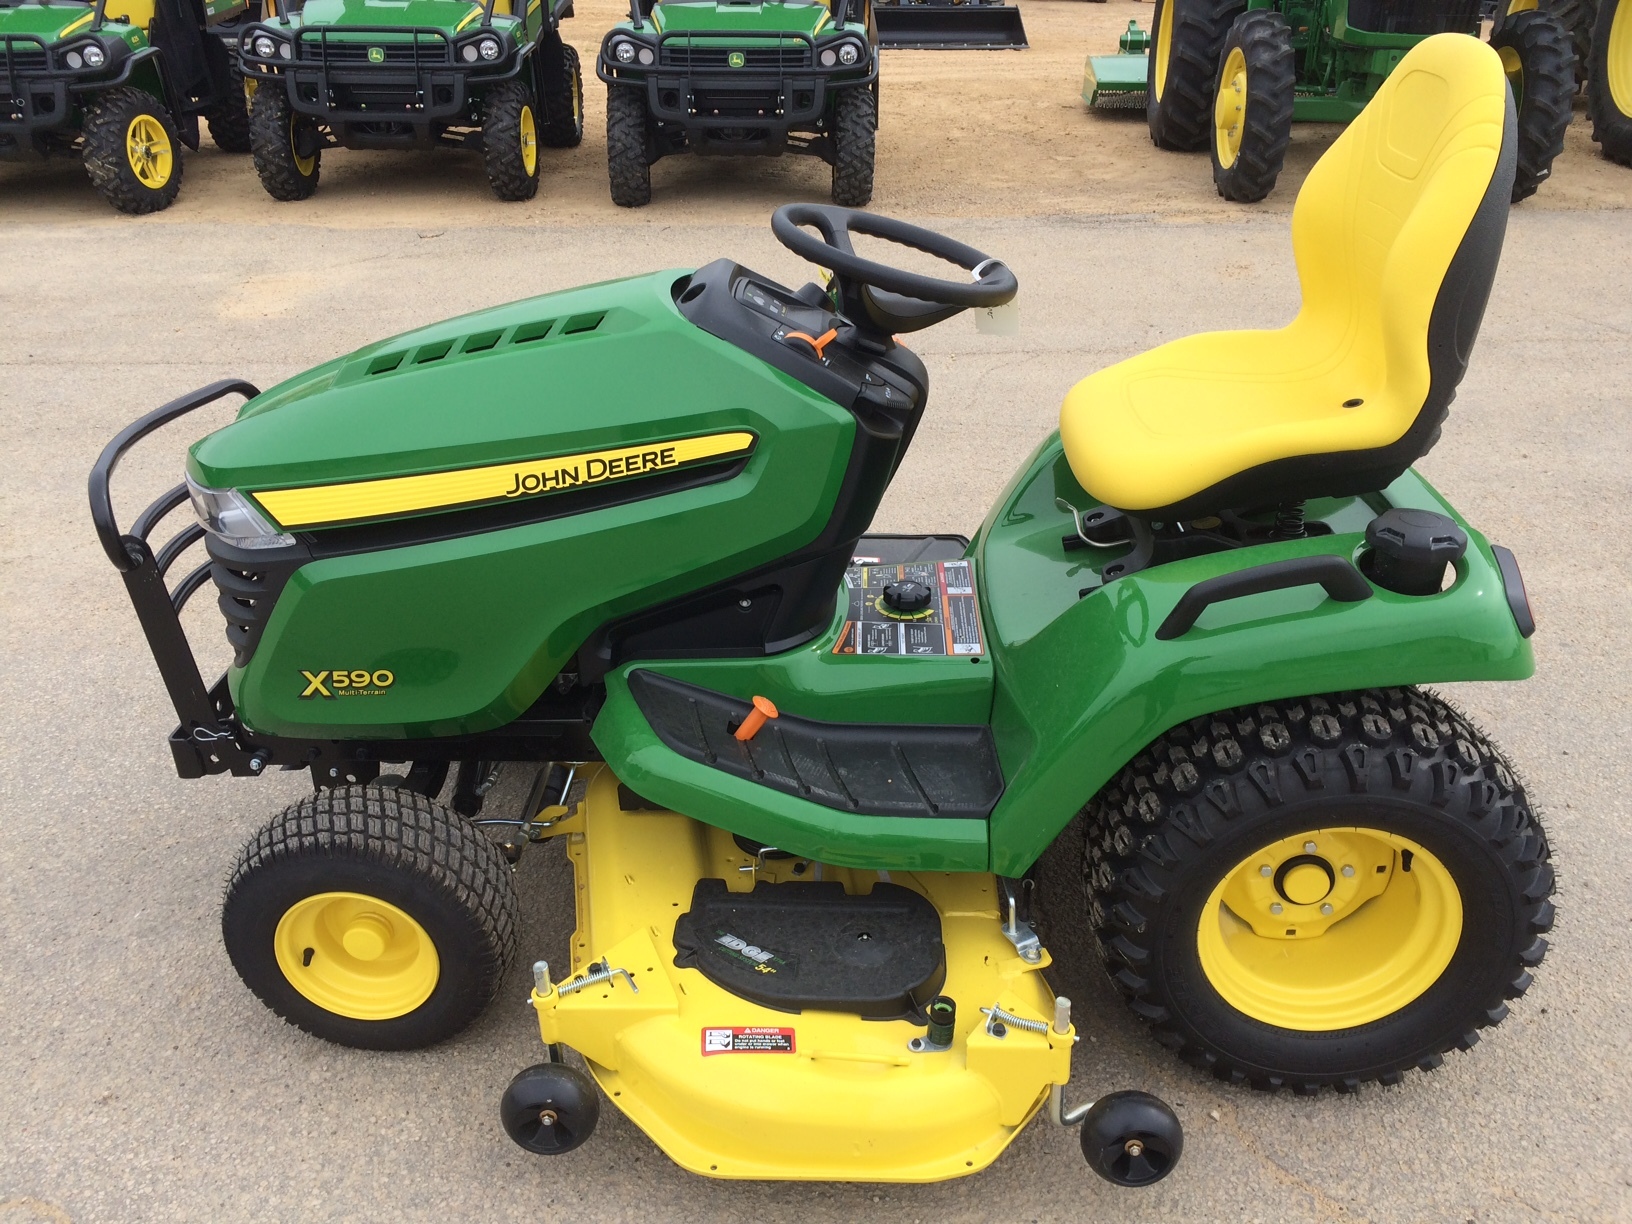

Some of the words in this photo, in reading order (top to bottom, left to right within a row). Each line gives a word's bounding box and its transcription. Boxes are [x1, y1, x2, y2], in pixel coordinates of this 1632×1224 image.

[506, 466, 579, 495] JOHN
[586, 447, 676, 480] DEERE
[301, 669, 394, 697] X590
[714, 933, 774, 963] EDGE
